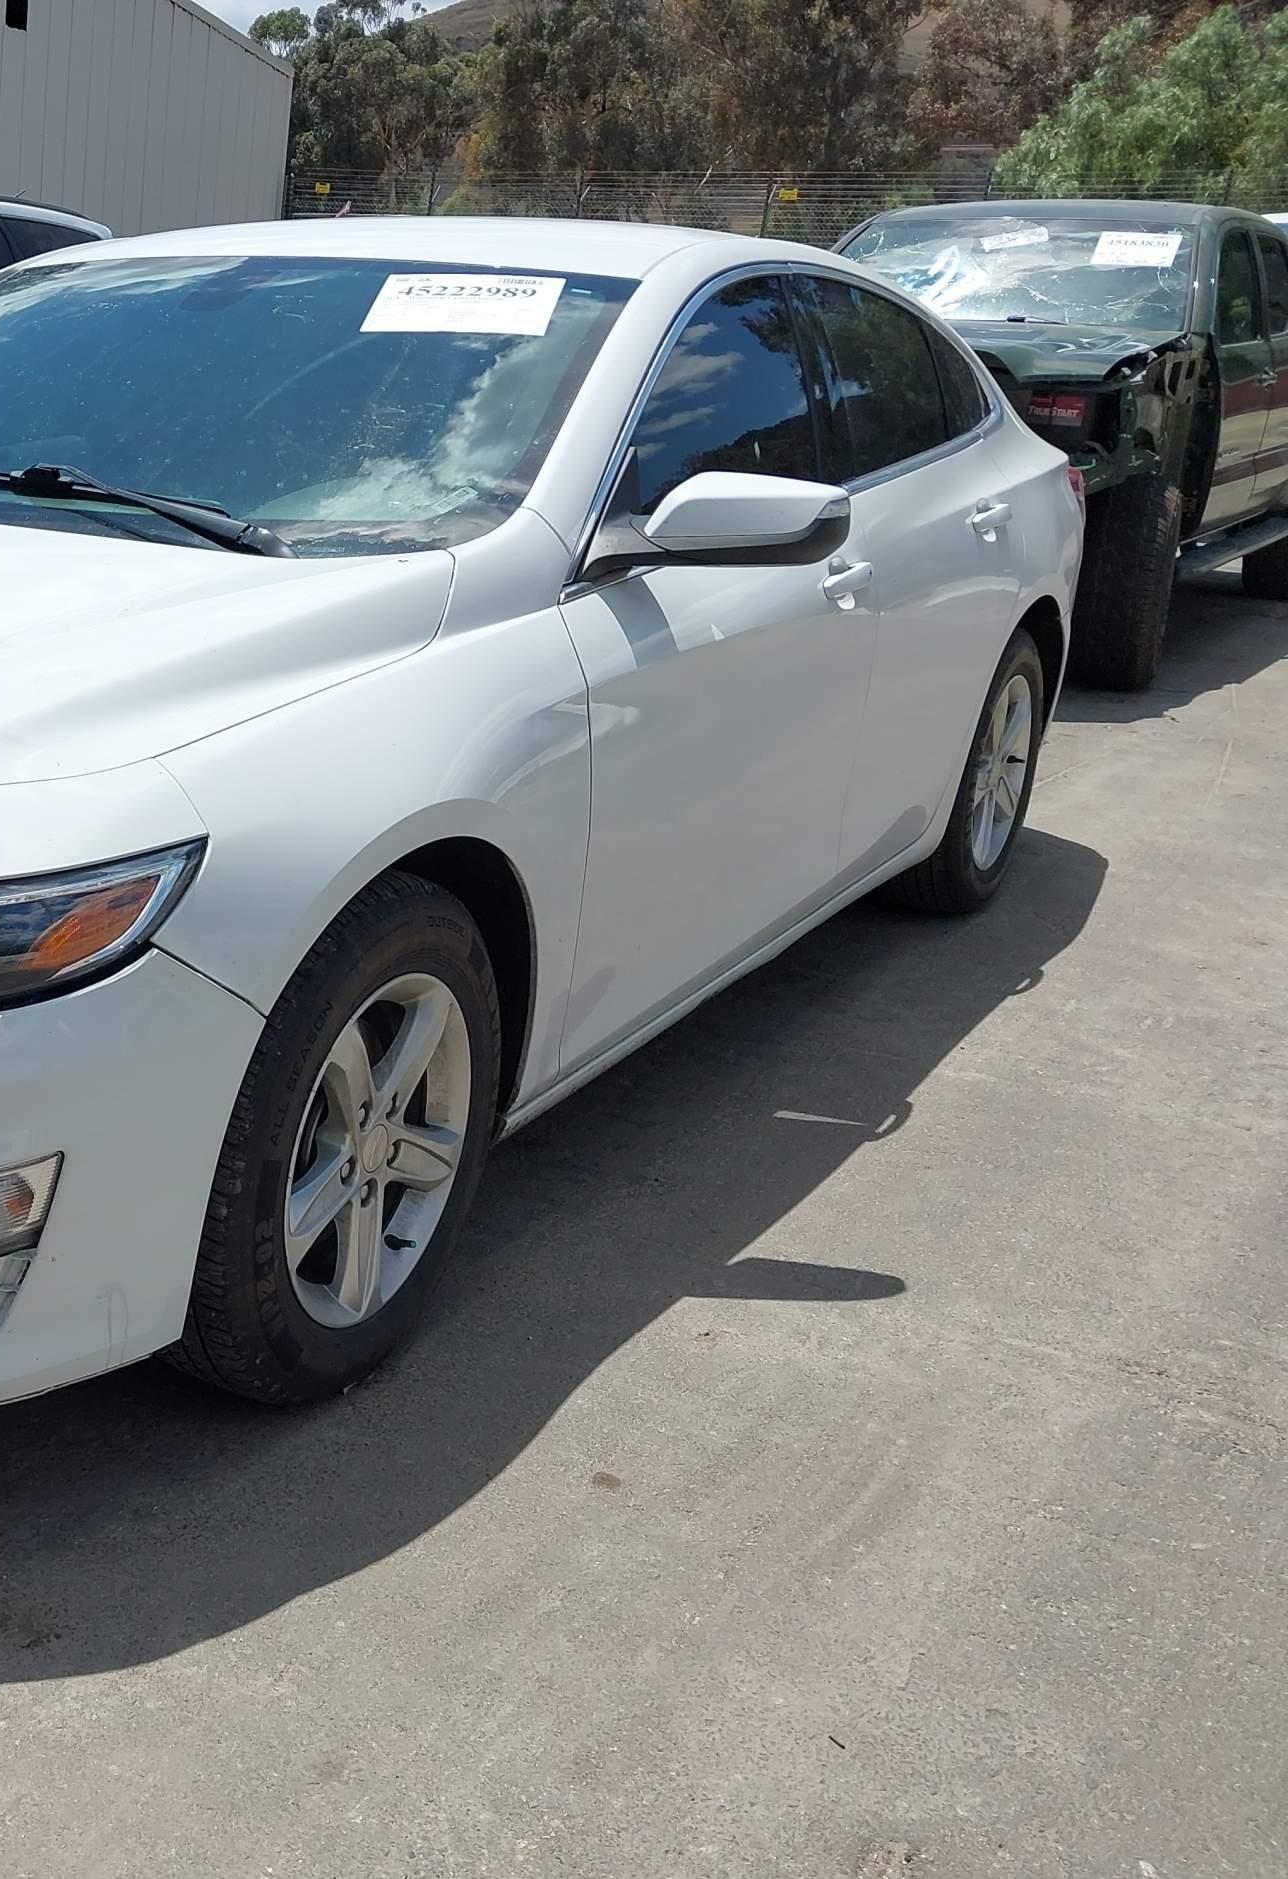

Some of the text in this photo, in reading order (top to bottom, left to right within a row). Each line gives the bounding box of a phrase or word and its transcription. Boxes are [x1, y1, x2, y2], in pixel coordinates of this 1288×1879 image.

[397, 286, 537, 298] 45222989
[270, 1001, 333, 1146] ALL SEASON
